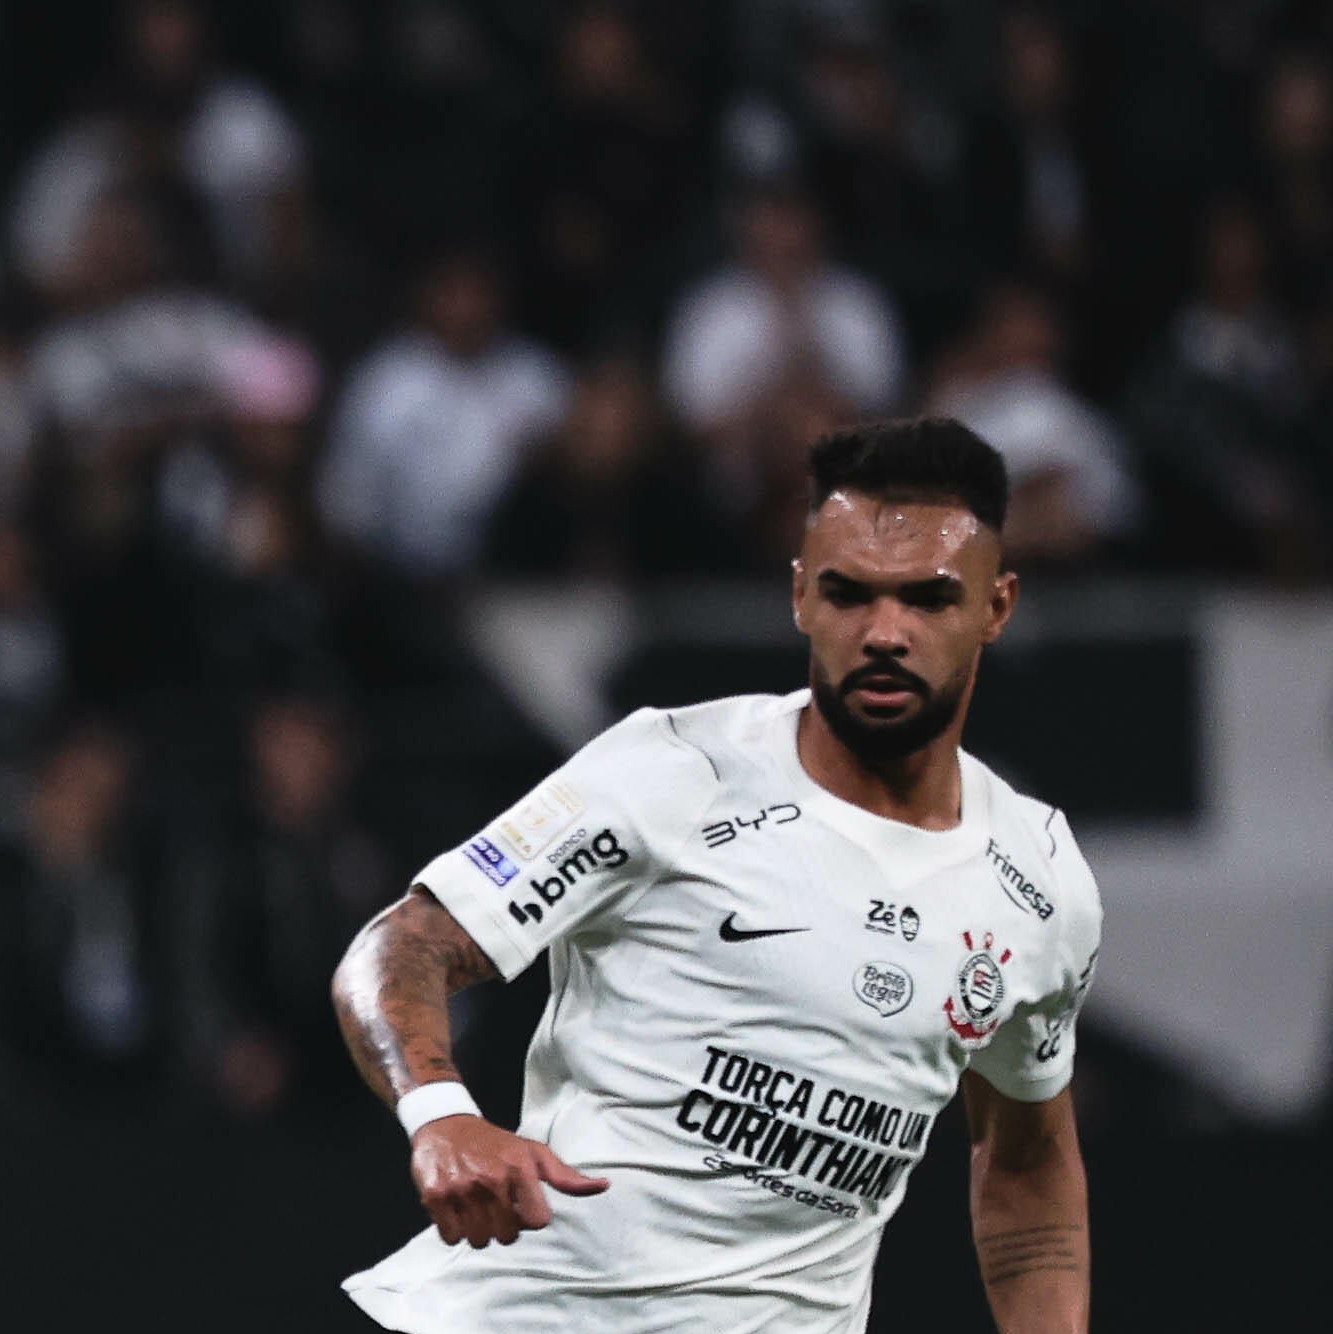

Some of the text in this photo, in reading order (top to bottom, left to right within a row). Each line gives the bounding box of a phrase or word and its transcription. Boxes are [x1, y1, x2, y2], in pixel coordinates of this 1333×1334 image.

[530, 828, 629, 907] bmg
[701, 804, 801, 849] BYD
[985, 837, 1055, 921] Frimesa
[701, 1045, 814, 1119] TORÇA
[817, 1088, 902, 1147] COMO
[676, 1089, 912, 1201] CORINTHIAN
